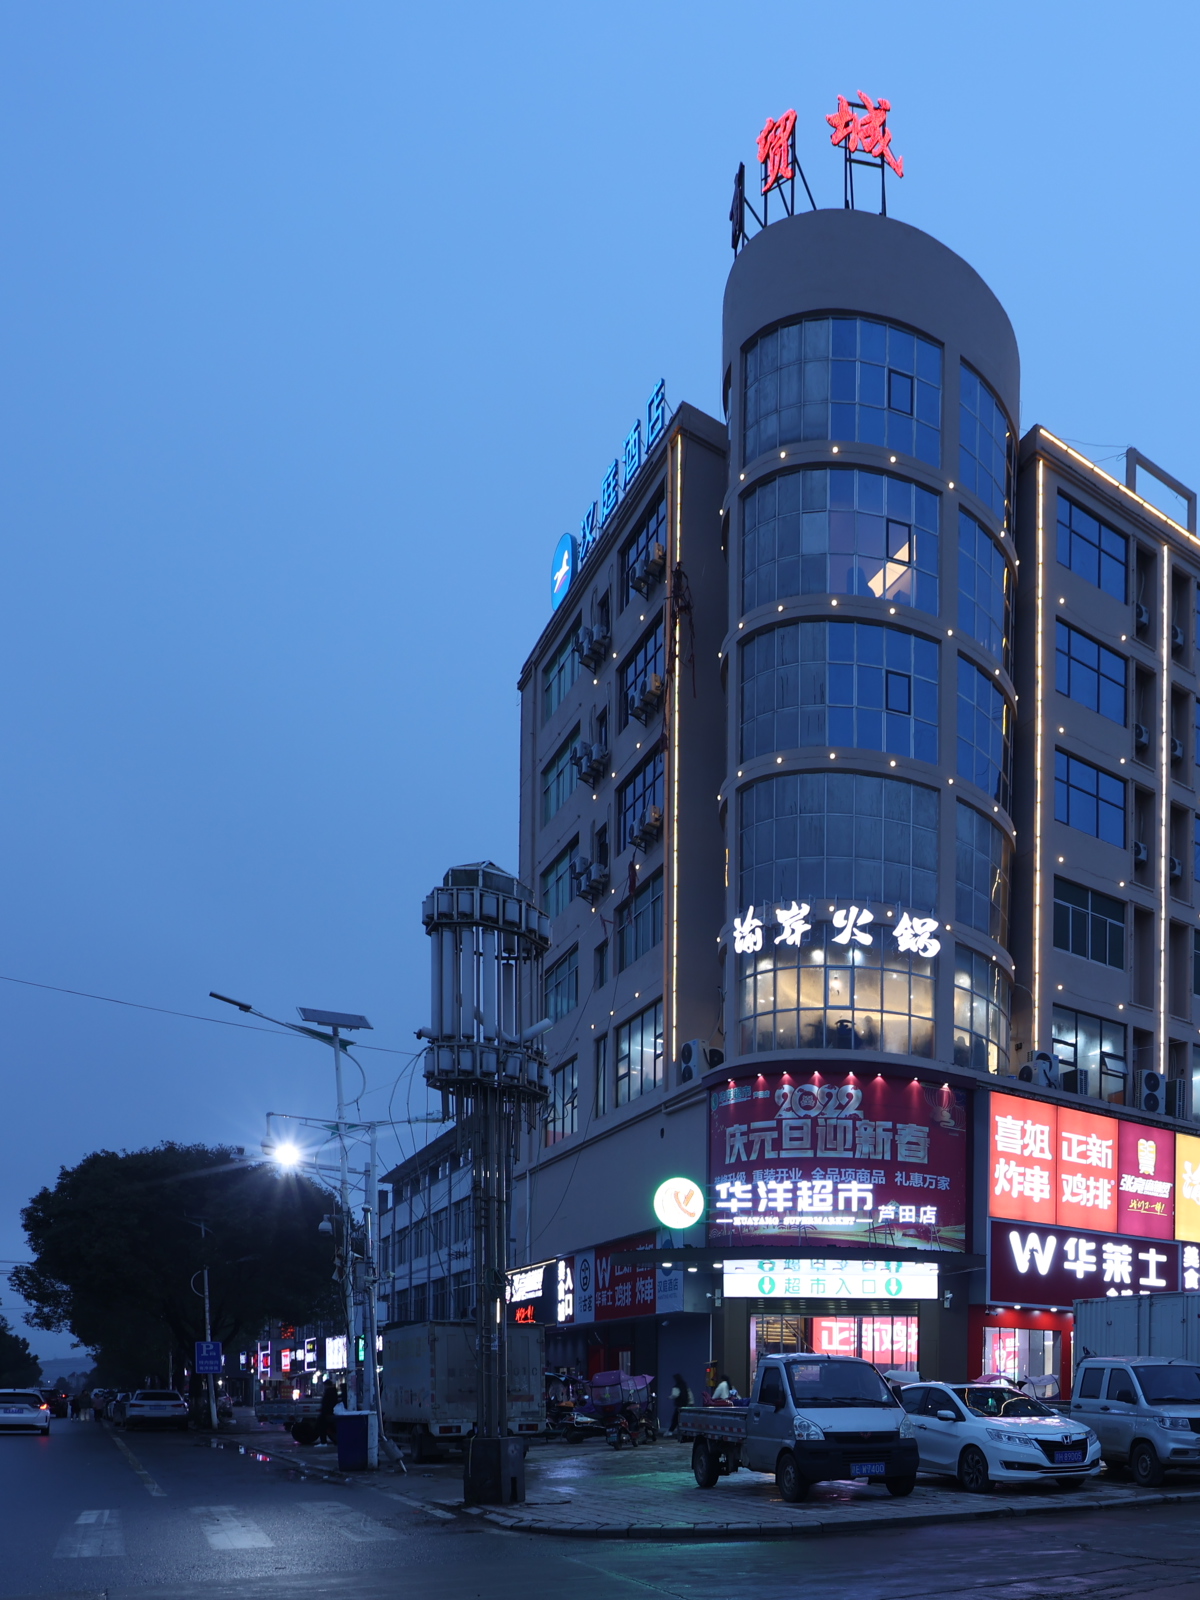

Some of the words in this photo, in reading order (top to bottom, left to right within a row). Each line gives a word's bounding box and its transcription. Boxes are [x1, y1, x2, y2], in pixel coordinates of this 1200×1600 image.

[579, 378, 665, 563] 汉庭酒店
[774, 1084, 863, 1119] 2022
[725, 1118, 930, 1164] 庆元旦迎新春
[995, 1115, 1053, 1161] 喜姐
[1061, 1131, 1113, 1169] 正新
[752, 1167, 803, 1185] 重装开业
[811, 1167, 886, 1185] 全品项商品
[895, 1171, 951, 1191] 礼惠万家
[994, 1158, 1051, 1203] 炸串
[1061, 1173, 1112, 1210] 鸡排
[715, 1180, 874, 1213] 华洋超市
[878, 1204, 937, 1225] 芦田店
[1063, 1237, 1167, 1287] 华莱士
[614, 1280, 632, 1307] 鸡排
[636, 1276, 654, 1305] 炸串
[657, 1278, 679, 1293] 汉庭酒店
[784, 1277, 876, 1295] 超市入口
[201, 1343, 214, 1356] P
